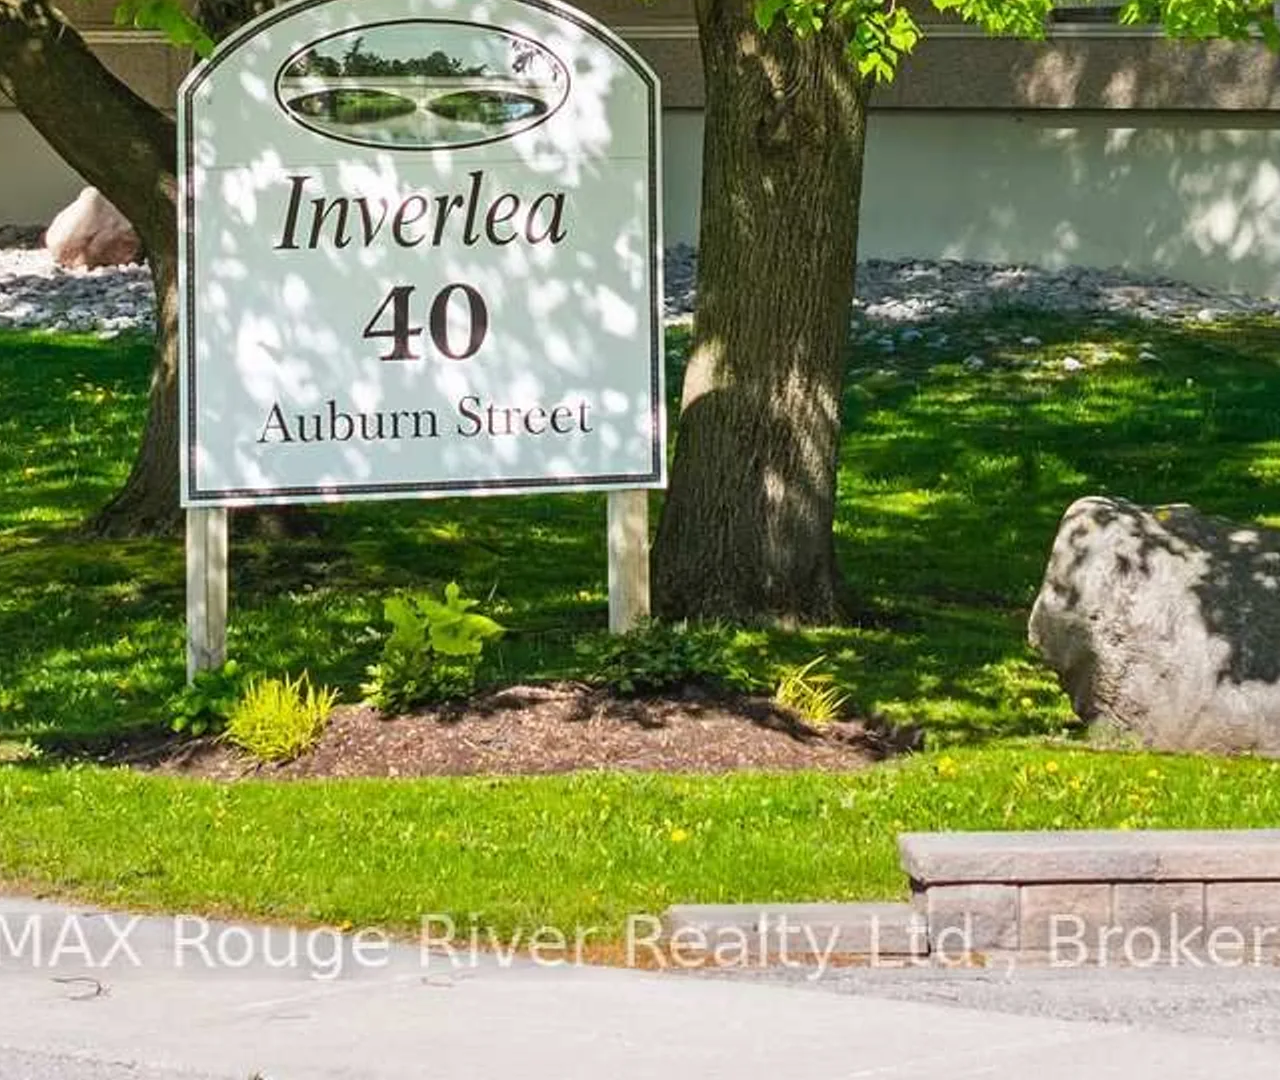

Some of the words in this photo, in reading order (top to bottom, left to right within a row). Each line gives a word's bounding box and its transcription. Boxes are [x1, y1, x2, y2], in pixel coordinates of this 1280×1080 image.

[274, 170, 568, 250] Inverlea
[362, 282, 488, 361] 40
[257, 401, 438, 444] Auburn
[457, 395, 593, 438] Street
